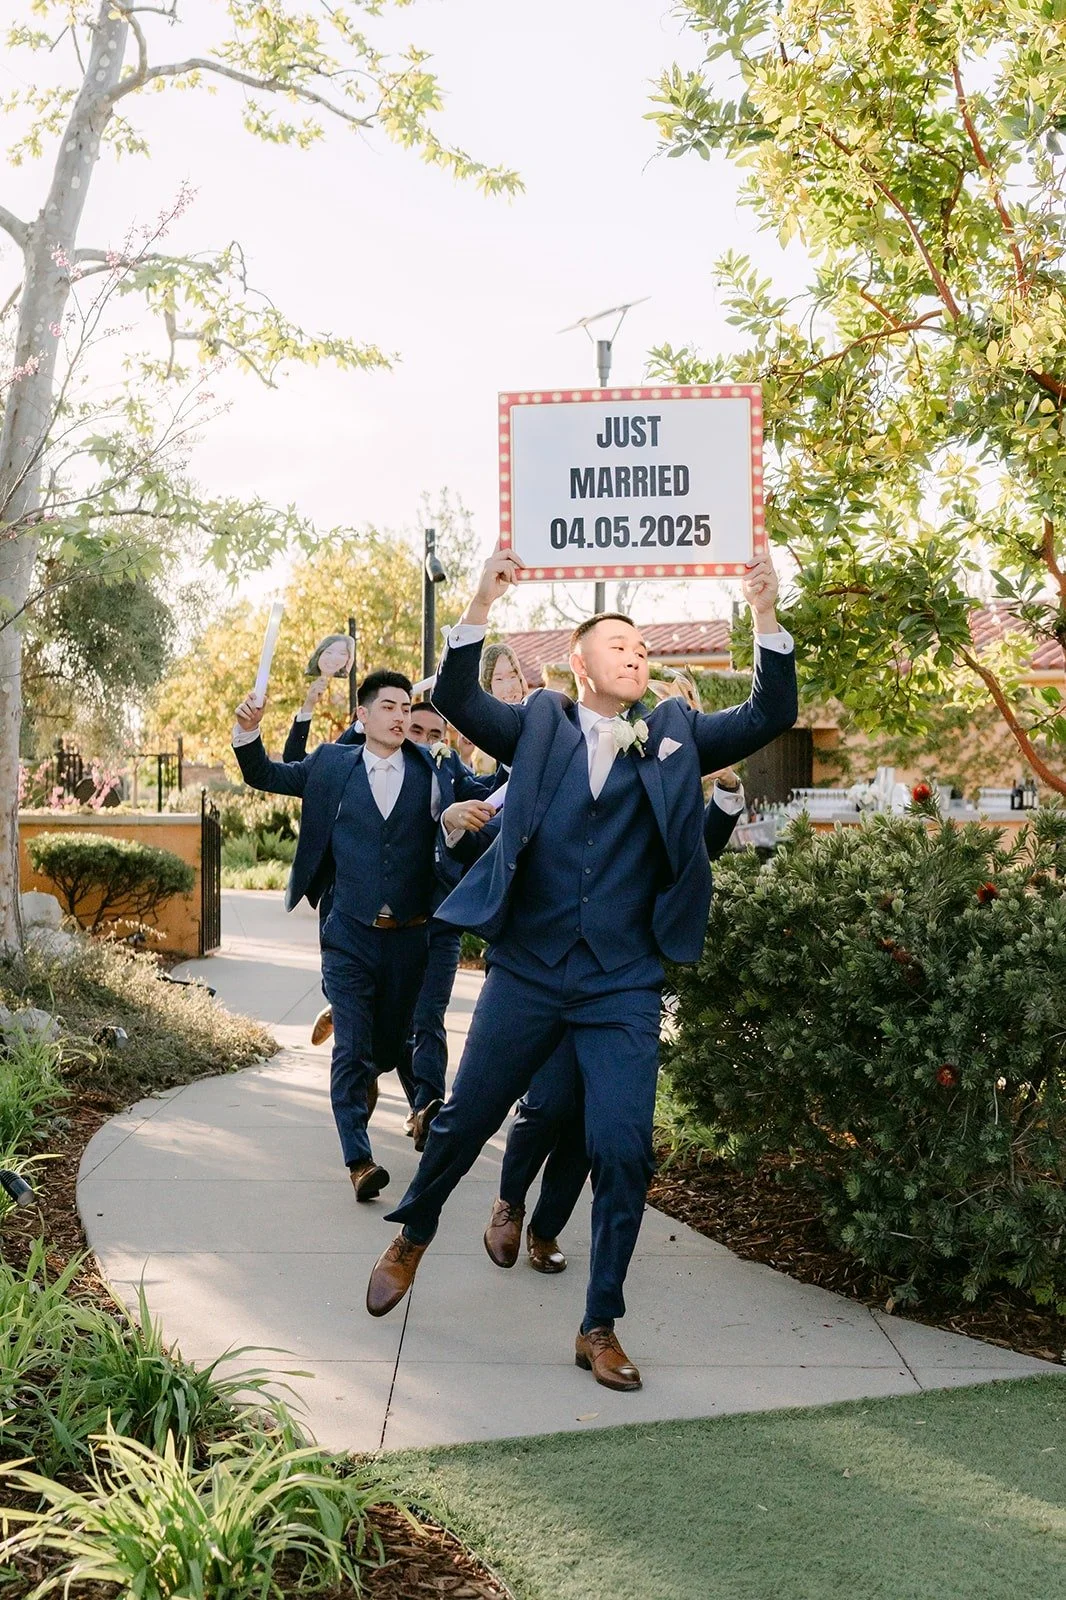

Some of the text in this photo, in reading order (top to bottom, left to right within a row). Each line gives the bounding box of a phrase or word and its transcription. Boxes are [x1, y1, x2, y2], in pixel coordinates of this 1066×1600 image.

[596, 415, 662, 449] JUST
[570, 464, 690, 499] MARRIED
[550, 514, 711, 550] 04.05.2025
